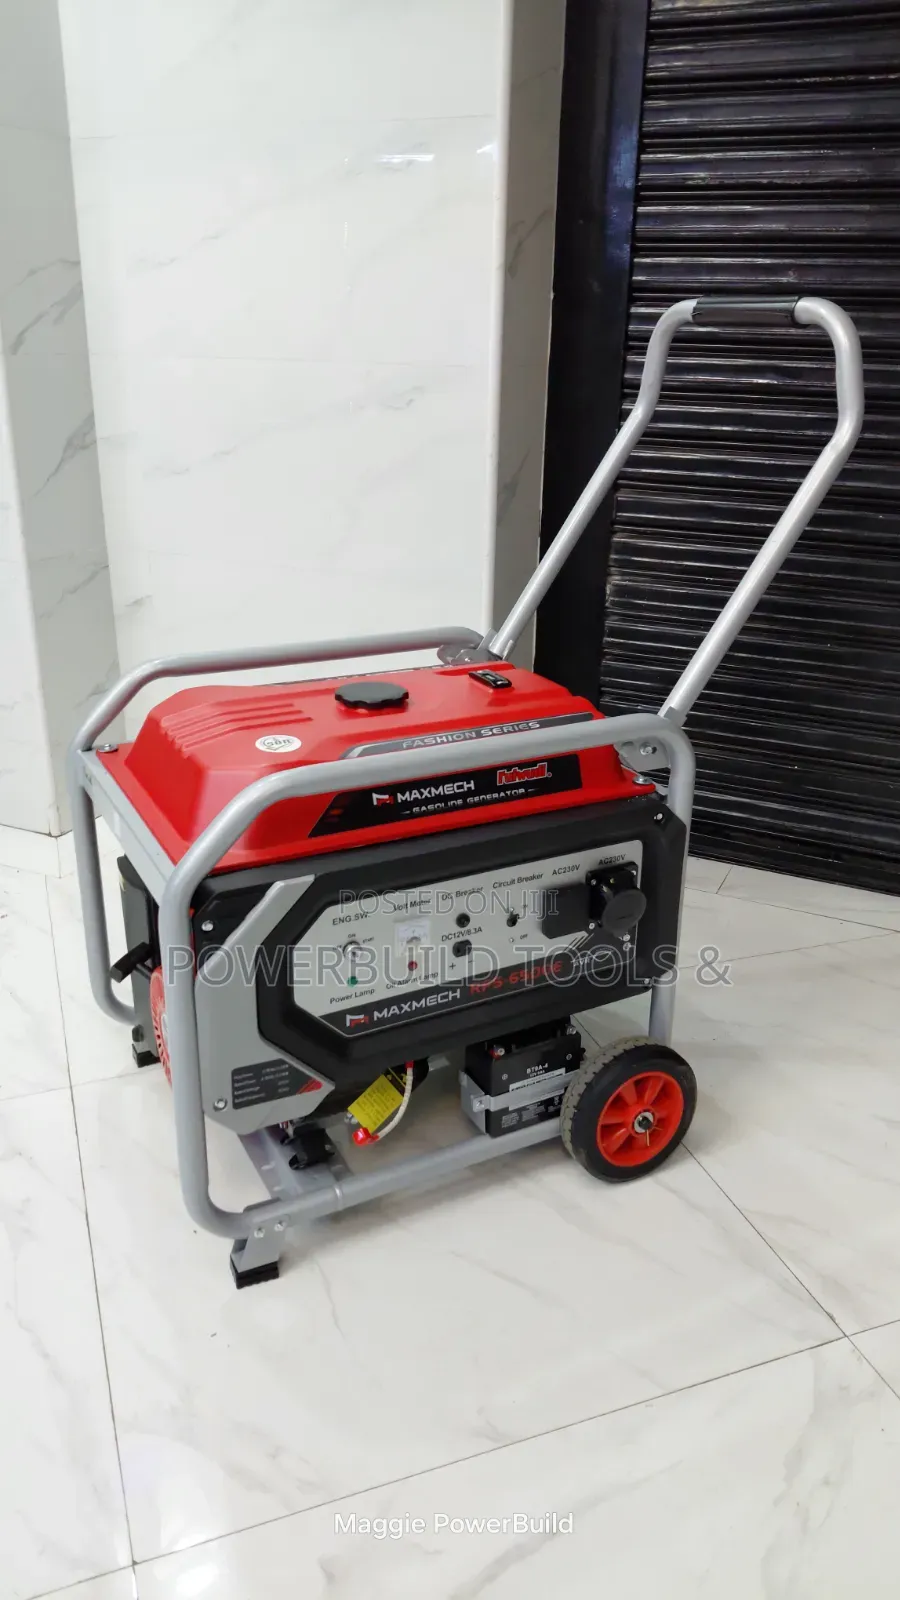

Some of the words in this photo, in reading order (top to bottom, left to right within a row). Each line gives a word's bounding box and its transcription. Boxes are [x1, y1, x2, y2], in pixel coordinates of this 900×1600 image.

[402, 731, 477, 749] FASHION
[480, 721, 540, 736] SERIES
[397, 780, 475, 803] MAXMECH
[412, 799, 463, 813] GASOLINE
[466, 788, 526, 804] GENERATOR
[598, 854, 627, 866] AC230V
[551, 864, 581, 876] AC230V
[492, 879, 516, 889] Circuit
[517, 873, 544, 884] Breaker
[455, 886, 484, 898] Breaker
[394, 902, 408, 911] Volt
[441, 926, 483, 942] DC12V/8.3A
[329, 993, 353, 1004] Power
[354, 988, 375, 998] Lamp
[373, 989, 461, 1021] MAXMECH
